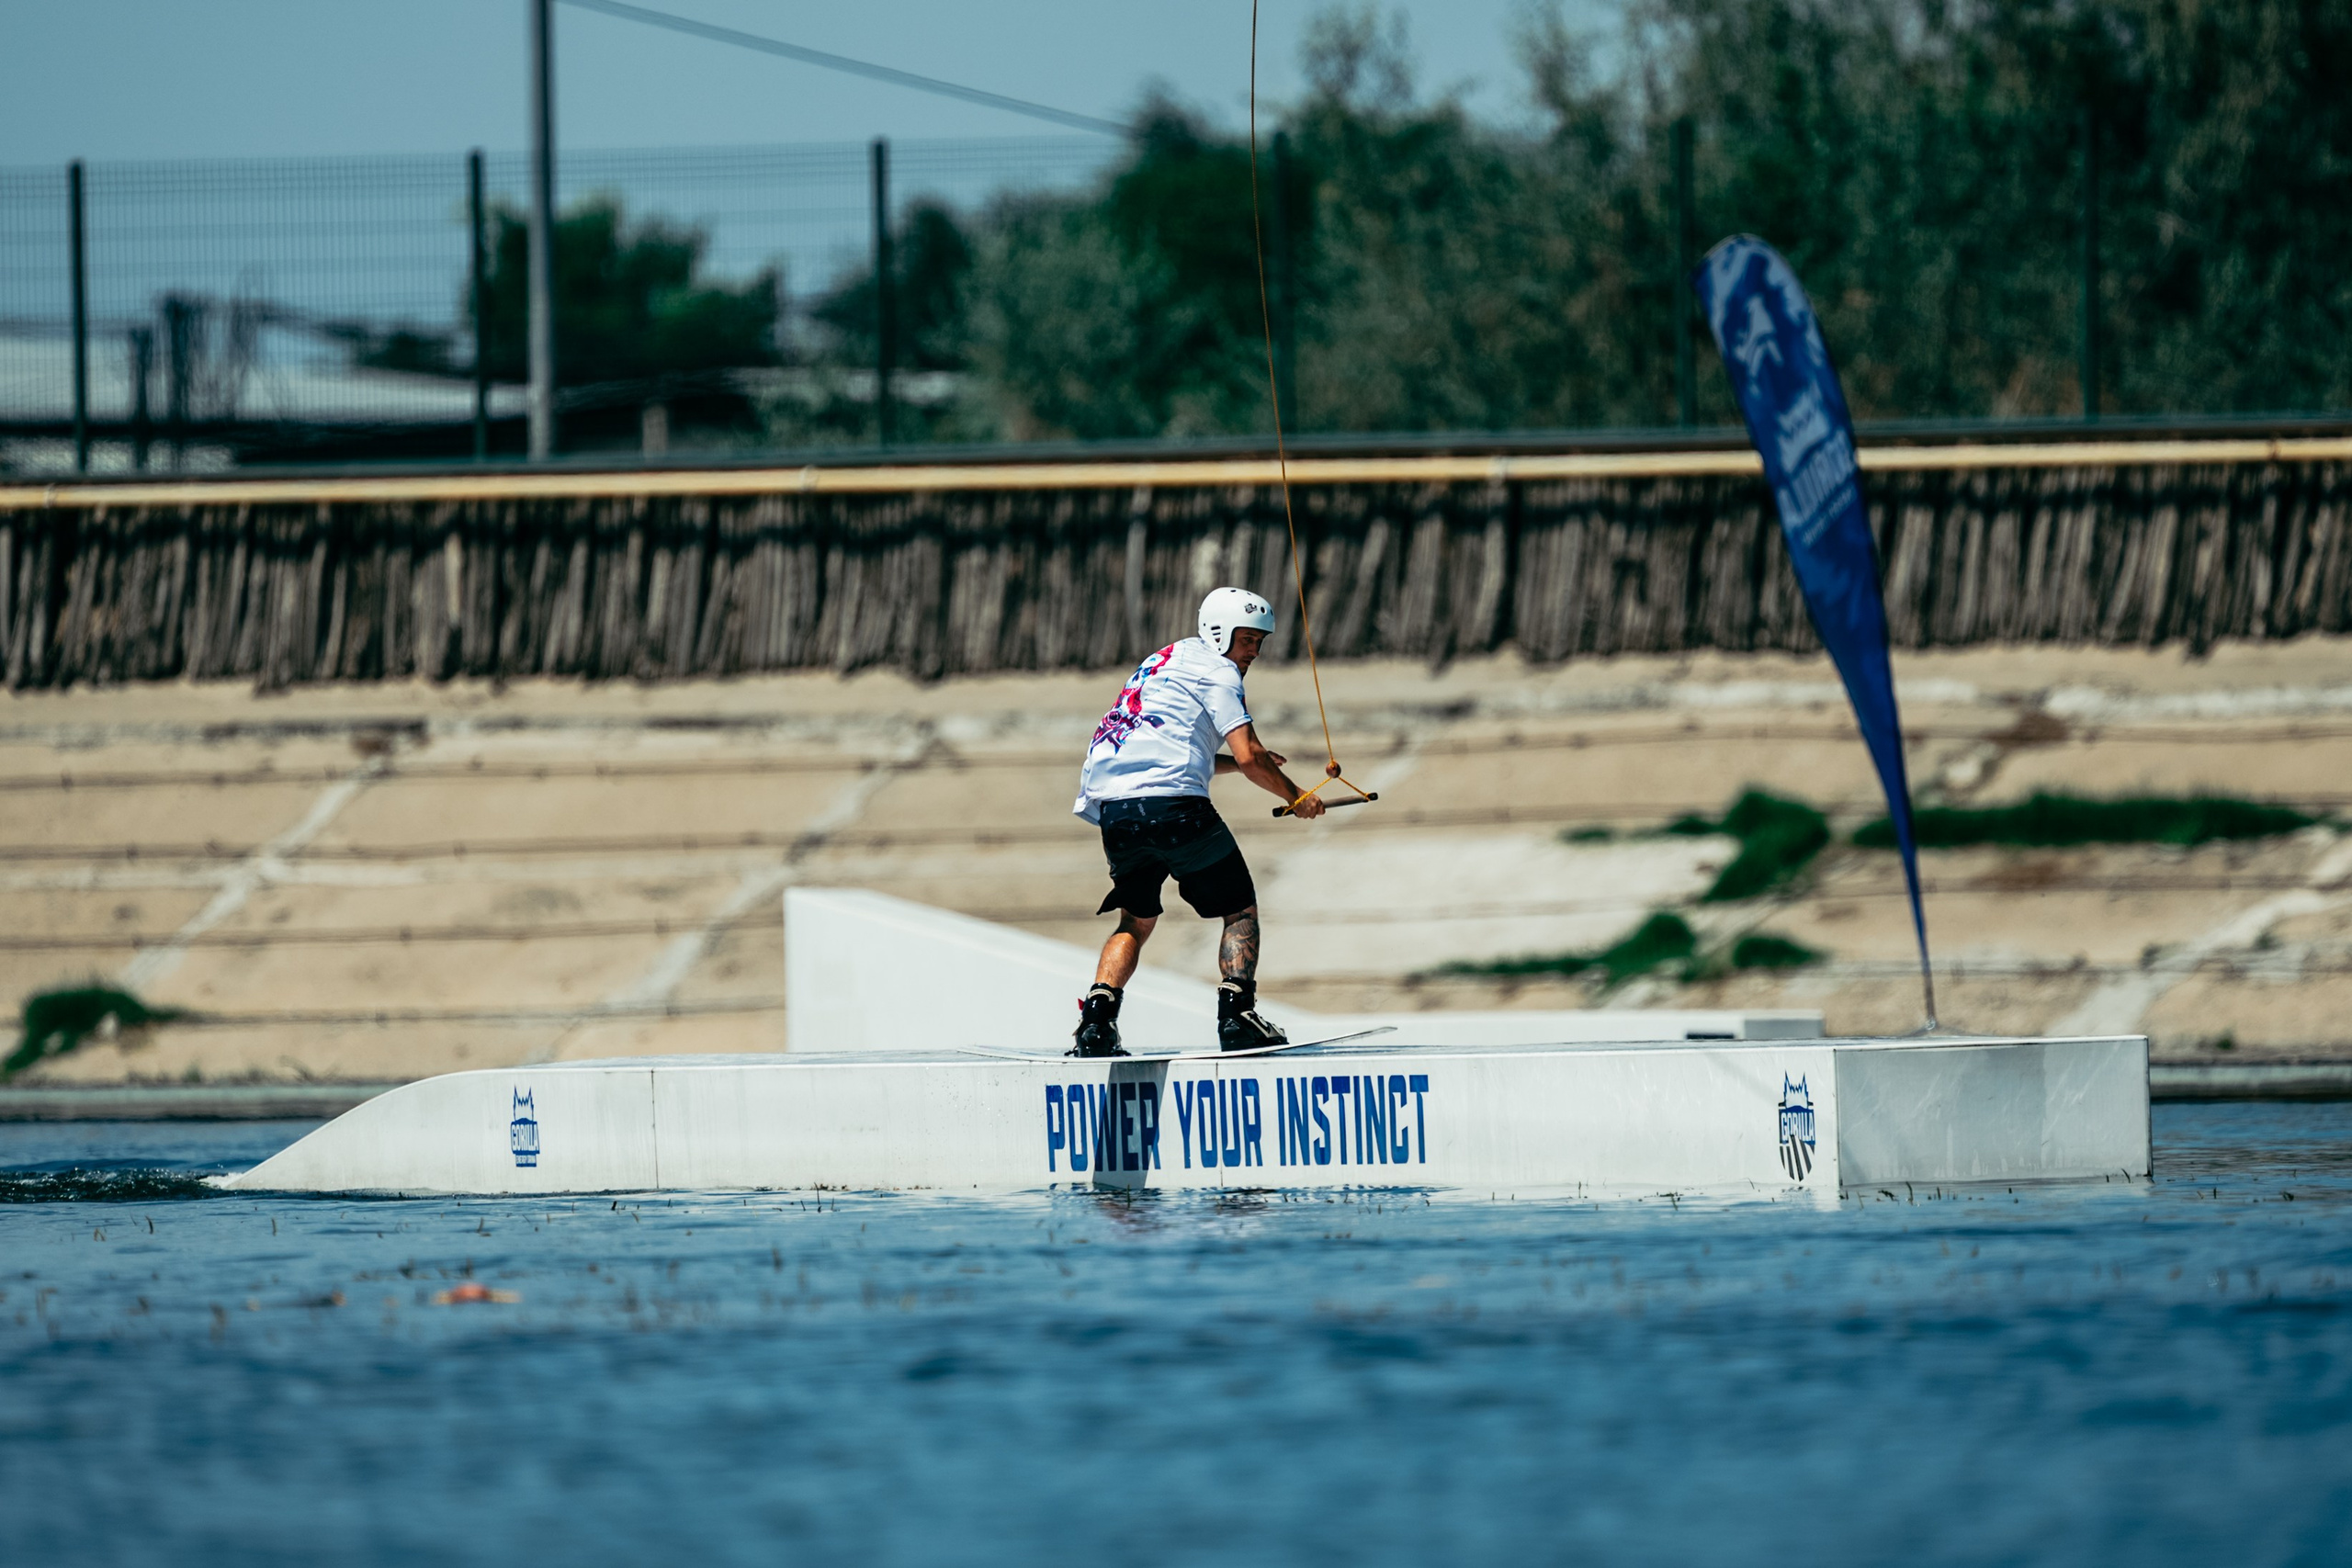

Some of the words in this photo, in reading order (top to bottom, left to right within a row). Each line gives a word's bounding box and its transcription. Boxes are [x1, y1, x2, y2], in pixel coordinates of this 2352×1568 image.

[511, 1123, 539, 1152] GORILLA
[1046, 1082, 1161, 1172] POWER
[1173, 1078, 1263, 1168] YOUR
[1276, 1074, 1430, 1167] INSTINCT
[1781, 1112, 1815, 1142] GORILLA
